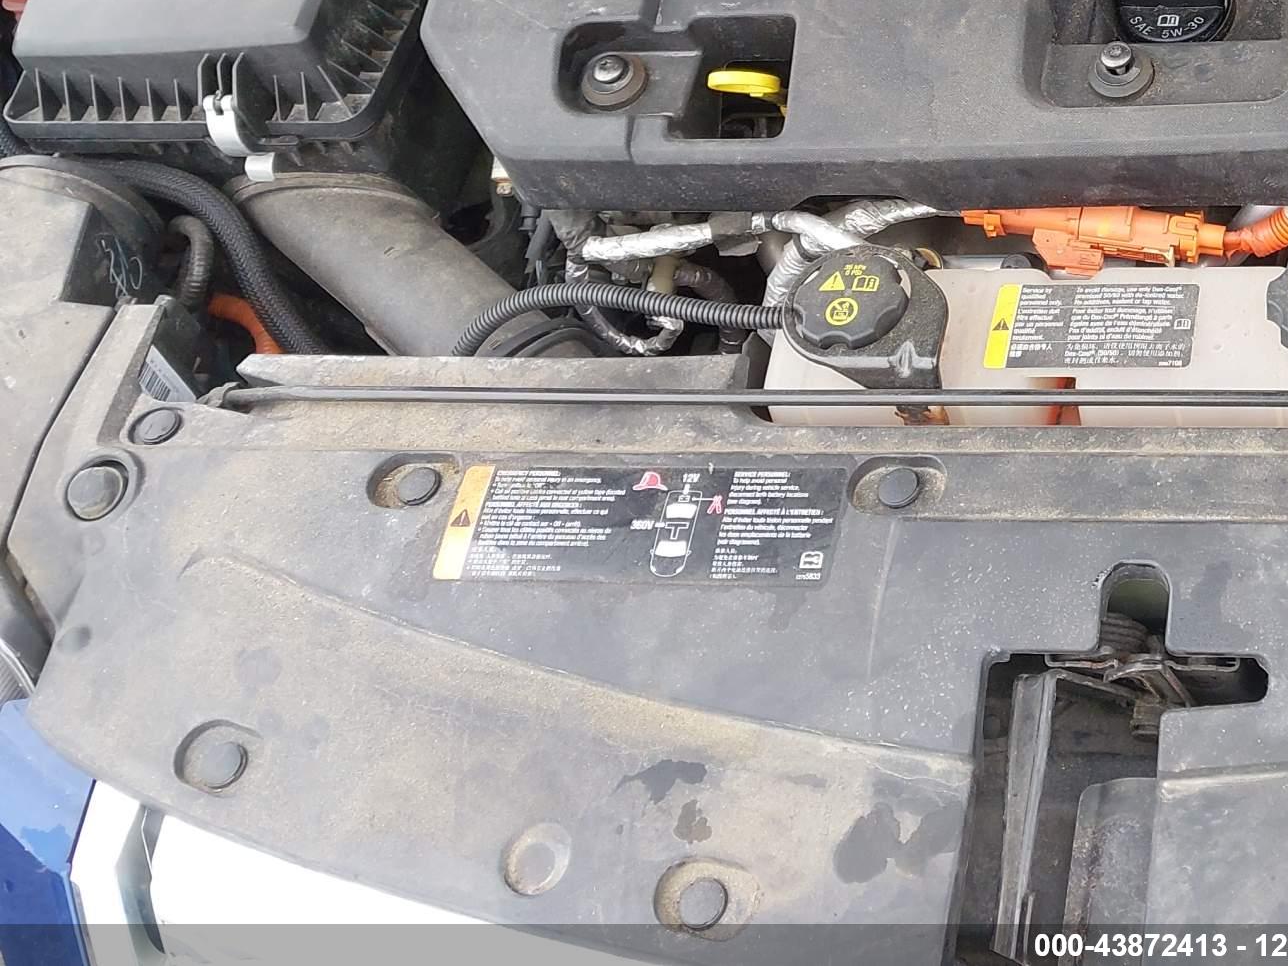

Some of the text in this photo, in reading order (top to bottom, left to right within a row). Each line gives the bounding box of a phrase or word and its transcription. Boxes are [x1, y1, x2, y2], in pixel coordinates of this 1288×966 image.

[1129, 15, 1204, 39] SAE 5W-30
[683, 474, 700, 483] 12V
